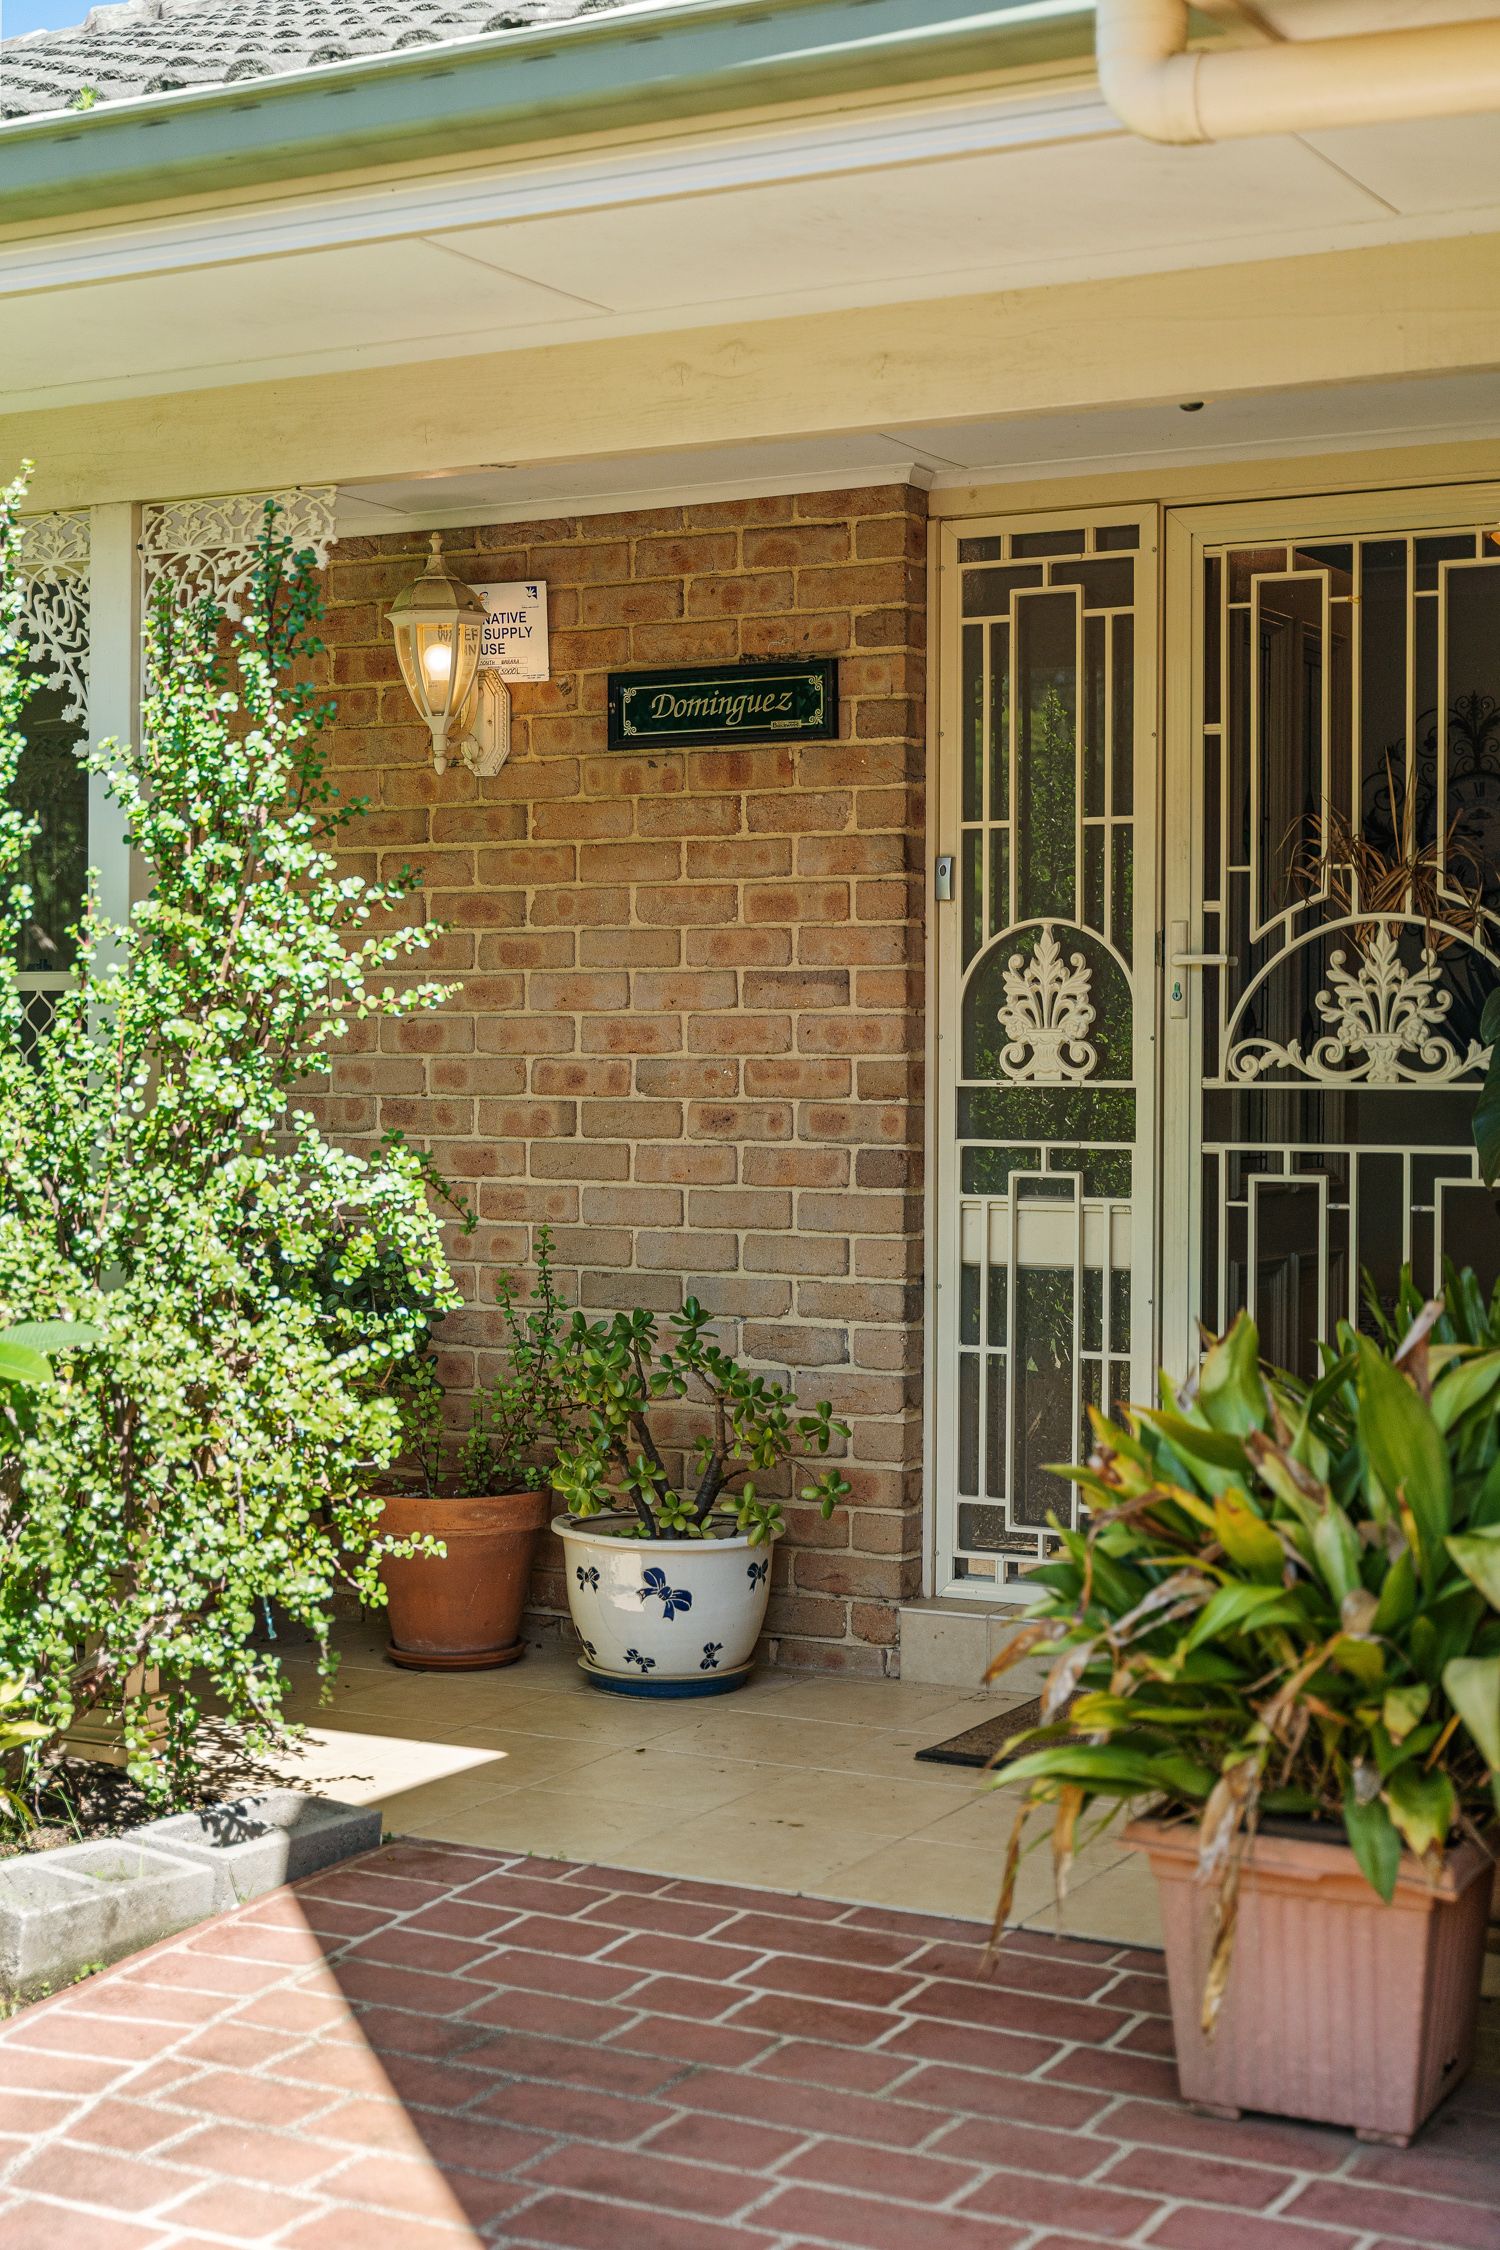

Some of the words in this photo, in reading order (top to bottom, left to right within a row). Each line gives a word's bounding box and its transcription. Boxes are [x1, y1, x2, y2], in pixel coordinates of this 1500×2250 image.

[484, 626, 533, 640] SUPPLY
[480, 643, 506, 655] USE
[651, 689, 793, 726] Dominguez
